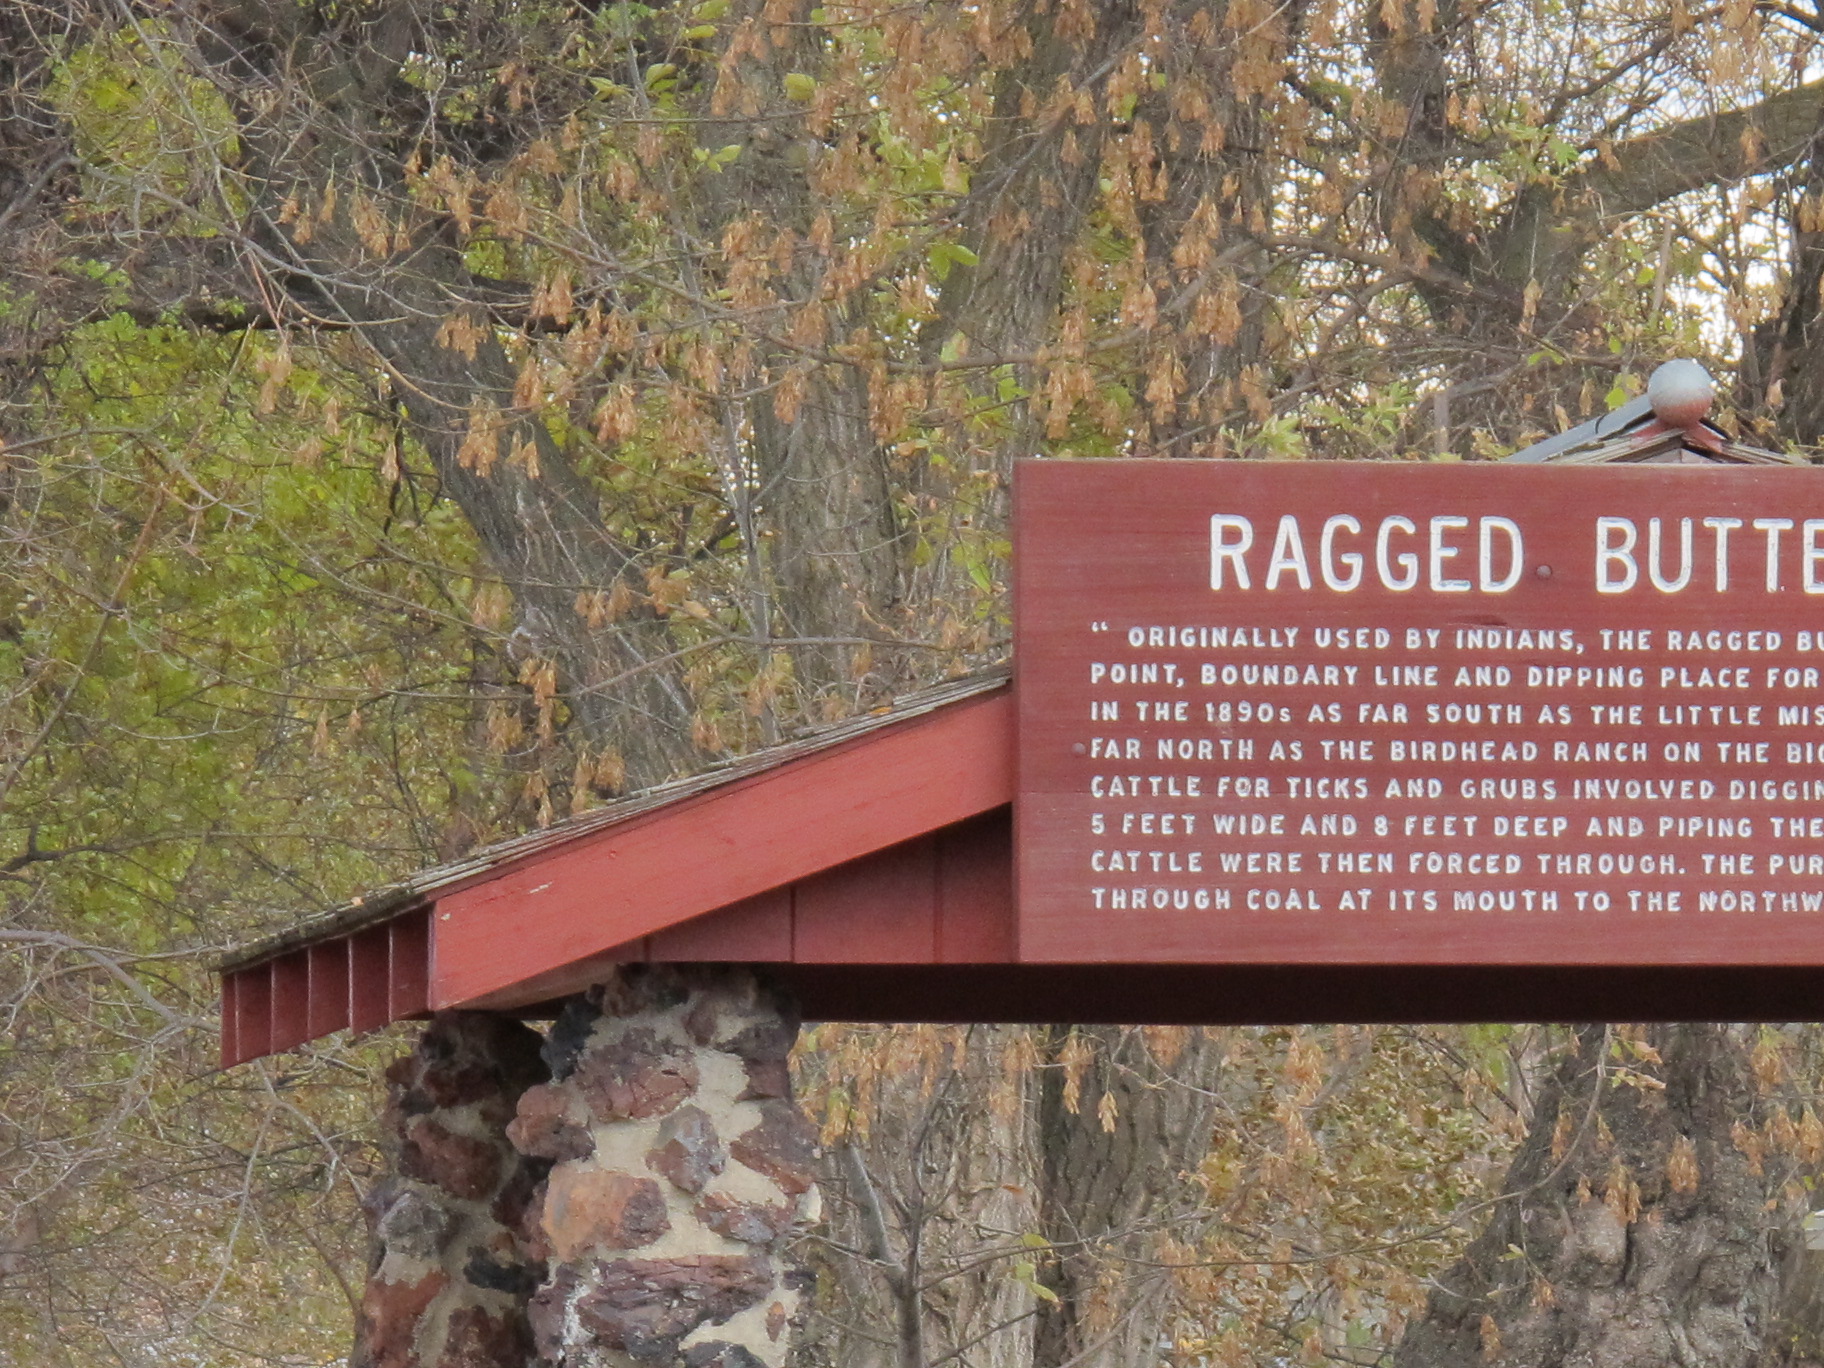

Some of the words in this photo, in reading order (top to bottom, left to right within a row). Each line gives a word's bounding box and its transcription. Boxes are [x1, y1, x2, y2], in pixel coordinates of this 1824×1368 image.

[1209, 513, 1526, 594] RAGGED
[1127, 625, 1299, 649] ORIGINALLY
[1314, 627, 1391, 650] USED
[1405, 627, 1441, 650] BY
[1455, 628, 1585, 655] INDIANS,
[1599, 628, 1652, 652] THE
[1667, 629, 1782, 652] RAGGED
[1090, 662, 1185, 688] POINT,
[1200, 663, 1358, 687] BOUNDARY
[1374, 665, 1439, 687] LINE
[1454, 665, 1511, 687] AND
[1527, 665, 1644, 689] DIPPING
[1660, 666, 1750, 689] PLACE
[1766, 667, 1819, 689] FOR
[1090, 700, 1119, 722] IN
[1135, 700, 1189, 722] THE
[1307, 702, 1342, 724] AS
[1358, 703, 1409, 724] FAR
[1426, 702, 1522, 725] SOUTH
[1537, 704, 1572, 726] AS
[1590, 705, 1643, 726] THE
[1658, 705, 1762, 726] LITTLE
[1090, 737, 1141, 760] FAR
[1157, 738, 1254, 761] NORTH
[1268, 739, 1303, 762] AS
[1319, 740, 1374, 762] THE
[1390, 740, 1538, 762] BIRDHEAD
[1553, 741, 1647, 763] RANCH
[1663, 741, 1701, 763] ON
[1716, 742, 1770, 764] THE
[1090, 775, 1201, 799] CATTLE
[1217, 776, 1270, 799] FOR
[1286, 776, 1368, 800] TICKS
[1384, 778, 1442, 799] AND
[1460, 778, 1557, 801] GRUBS
[1573, 778, 1715, 801] INVOLVED
[1091, 813, 1105, 835] 5
[1121, 813, 1196, 835] FEET
[1213, 813, 1285, 836] WIDE
[1300, 813, 1357, 837] AND
[1374, 815, 1389, 837] 8
[1404, 815, 1478, 837] FEET
[1494, 815, 1568, 838] DEEP
[1586, 816, 1645, 838] AND
[1658, 816, 1752, 839] PIPING
[1769, 817, 1824, 839] THE
[1091, 849, 1202, 873] CATTLE
[1219, 852, 1302, 874] WERE
[1317, 852, 1393, 874] THEN
[1409, 851, 1522, 875] FORCED
[1536, 853, 1686, 875] THROUGH.
[1701, 853, 1754, 876] THE
[1091, 887, 1231, 911] THROUGH
[1246, 888, 1321, 911] COAL
[1338, 888, 1373, 911] AT
[1389, 889, 1438, 912] ITS
[1453, 889, 1559, 912] MOUTH
[1573, 890, 1610, 912] TO
[1627, 890, 1681, 913] THE
